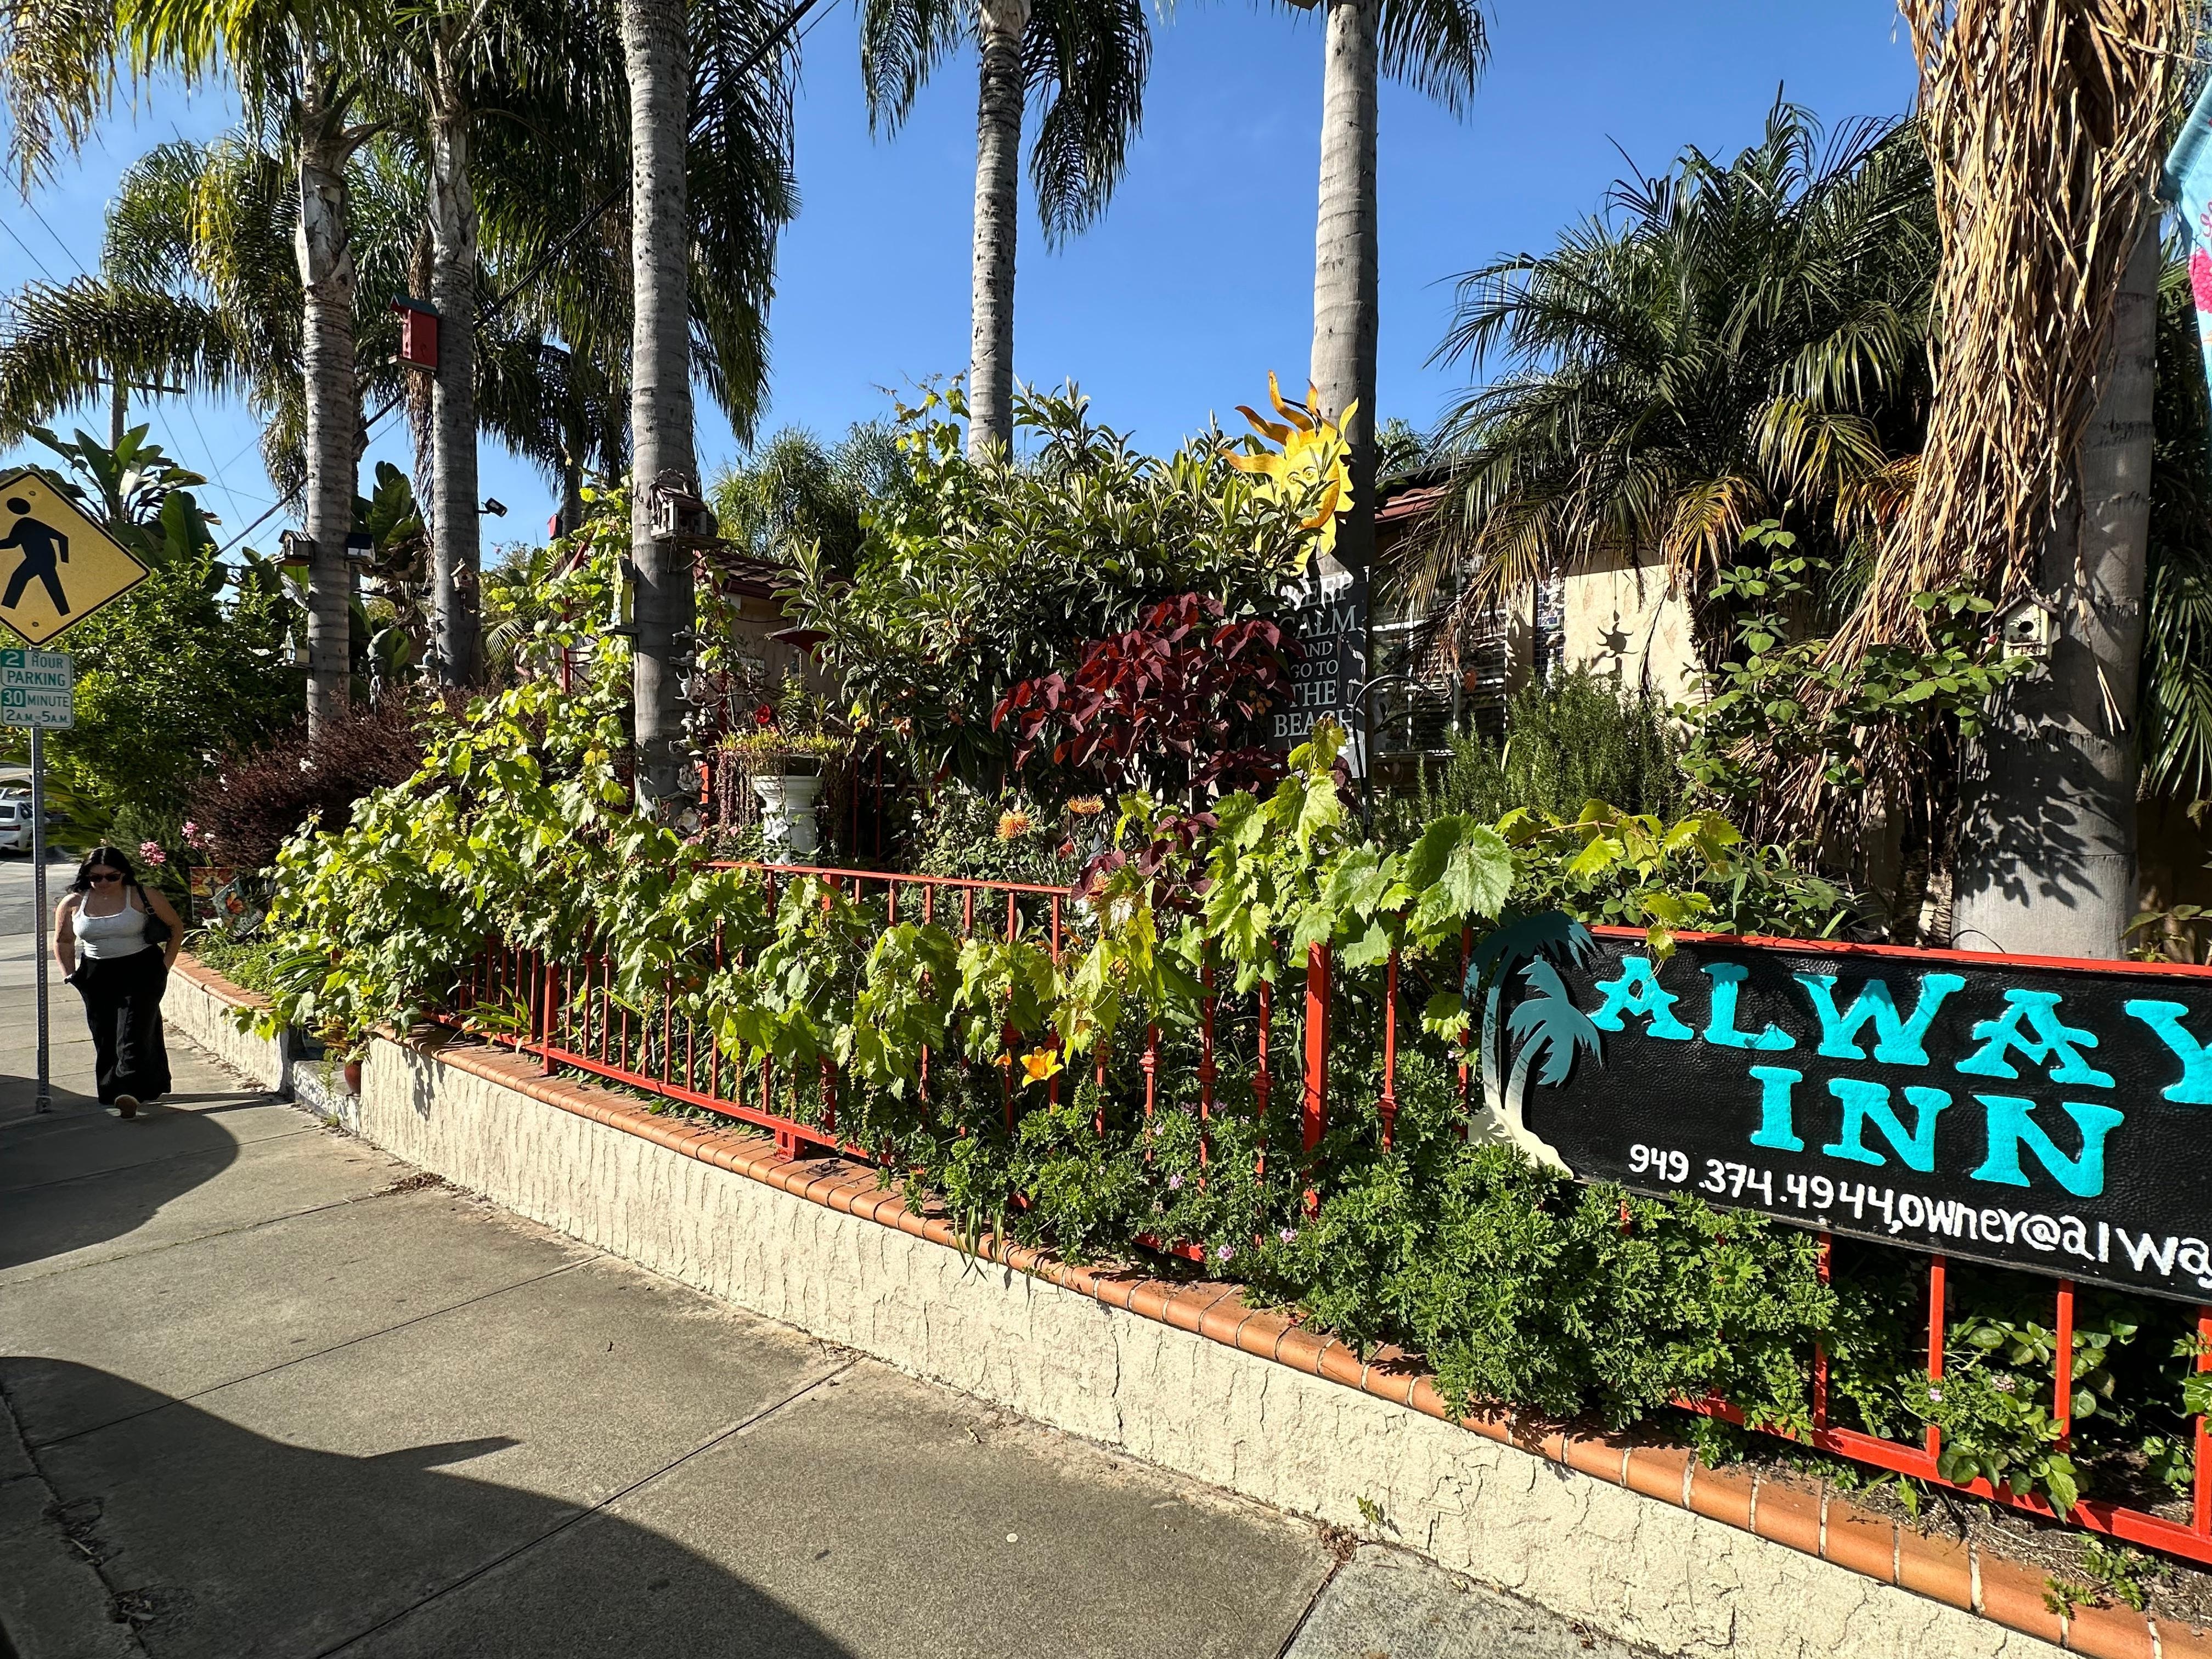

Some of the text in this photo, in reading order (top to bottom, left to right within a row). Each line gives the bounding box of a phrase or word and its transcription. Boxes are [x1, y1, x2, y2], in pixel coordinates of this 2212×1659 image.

[1284, 574, 1354, 610] KEEP
[1279, 605, 1357, 640] CALM
[5, 651, 64, 669] 2 HOUR
[1290, 659, 1339, 679] GO TO
[7, 670, 66, 686] PARKING
[3, 690, 70, 708] 30 MINUTE
[1290, 679, 1337, 708] THE
[1748, 1065, 2125, 1198] INN
